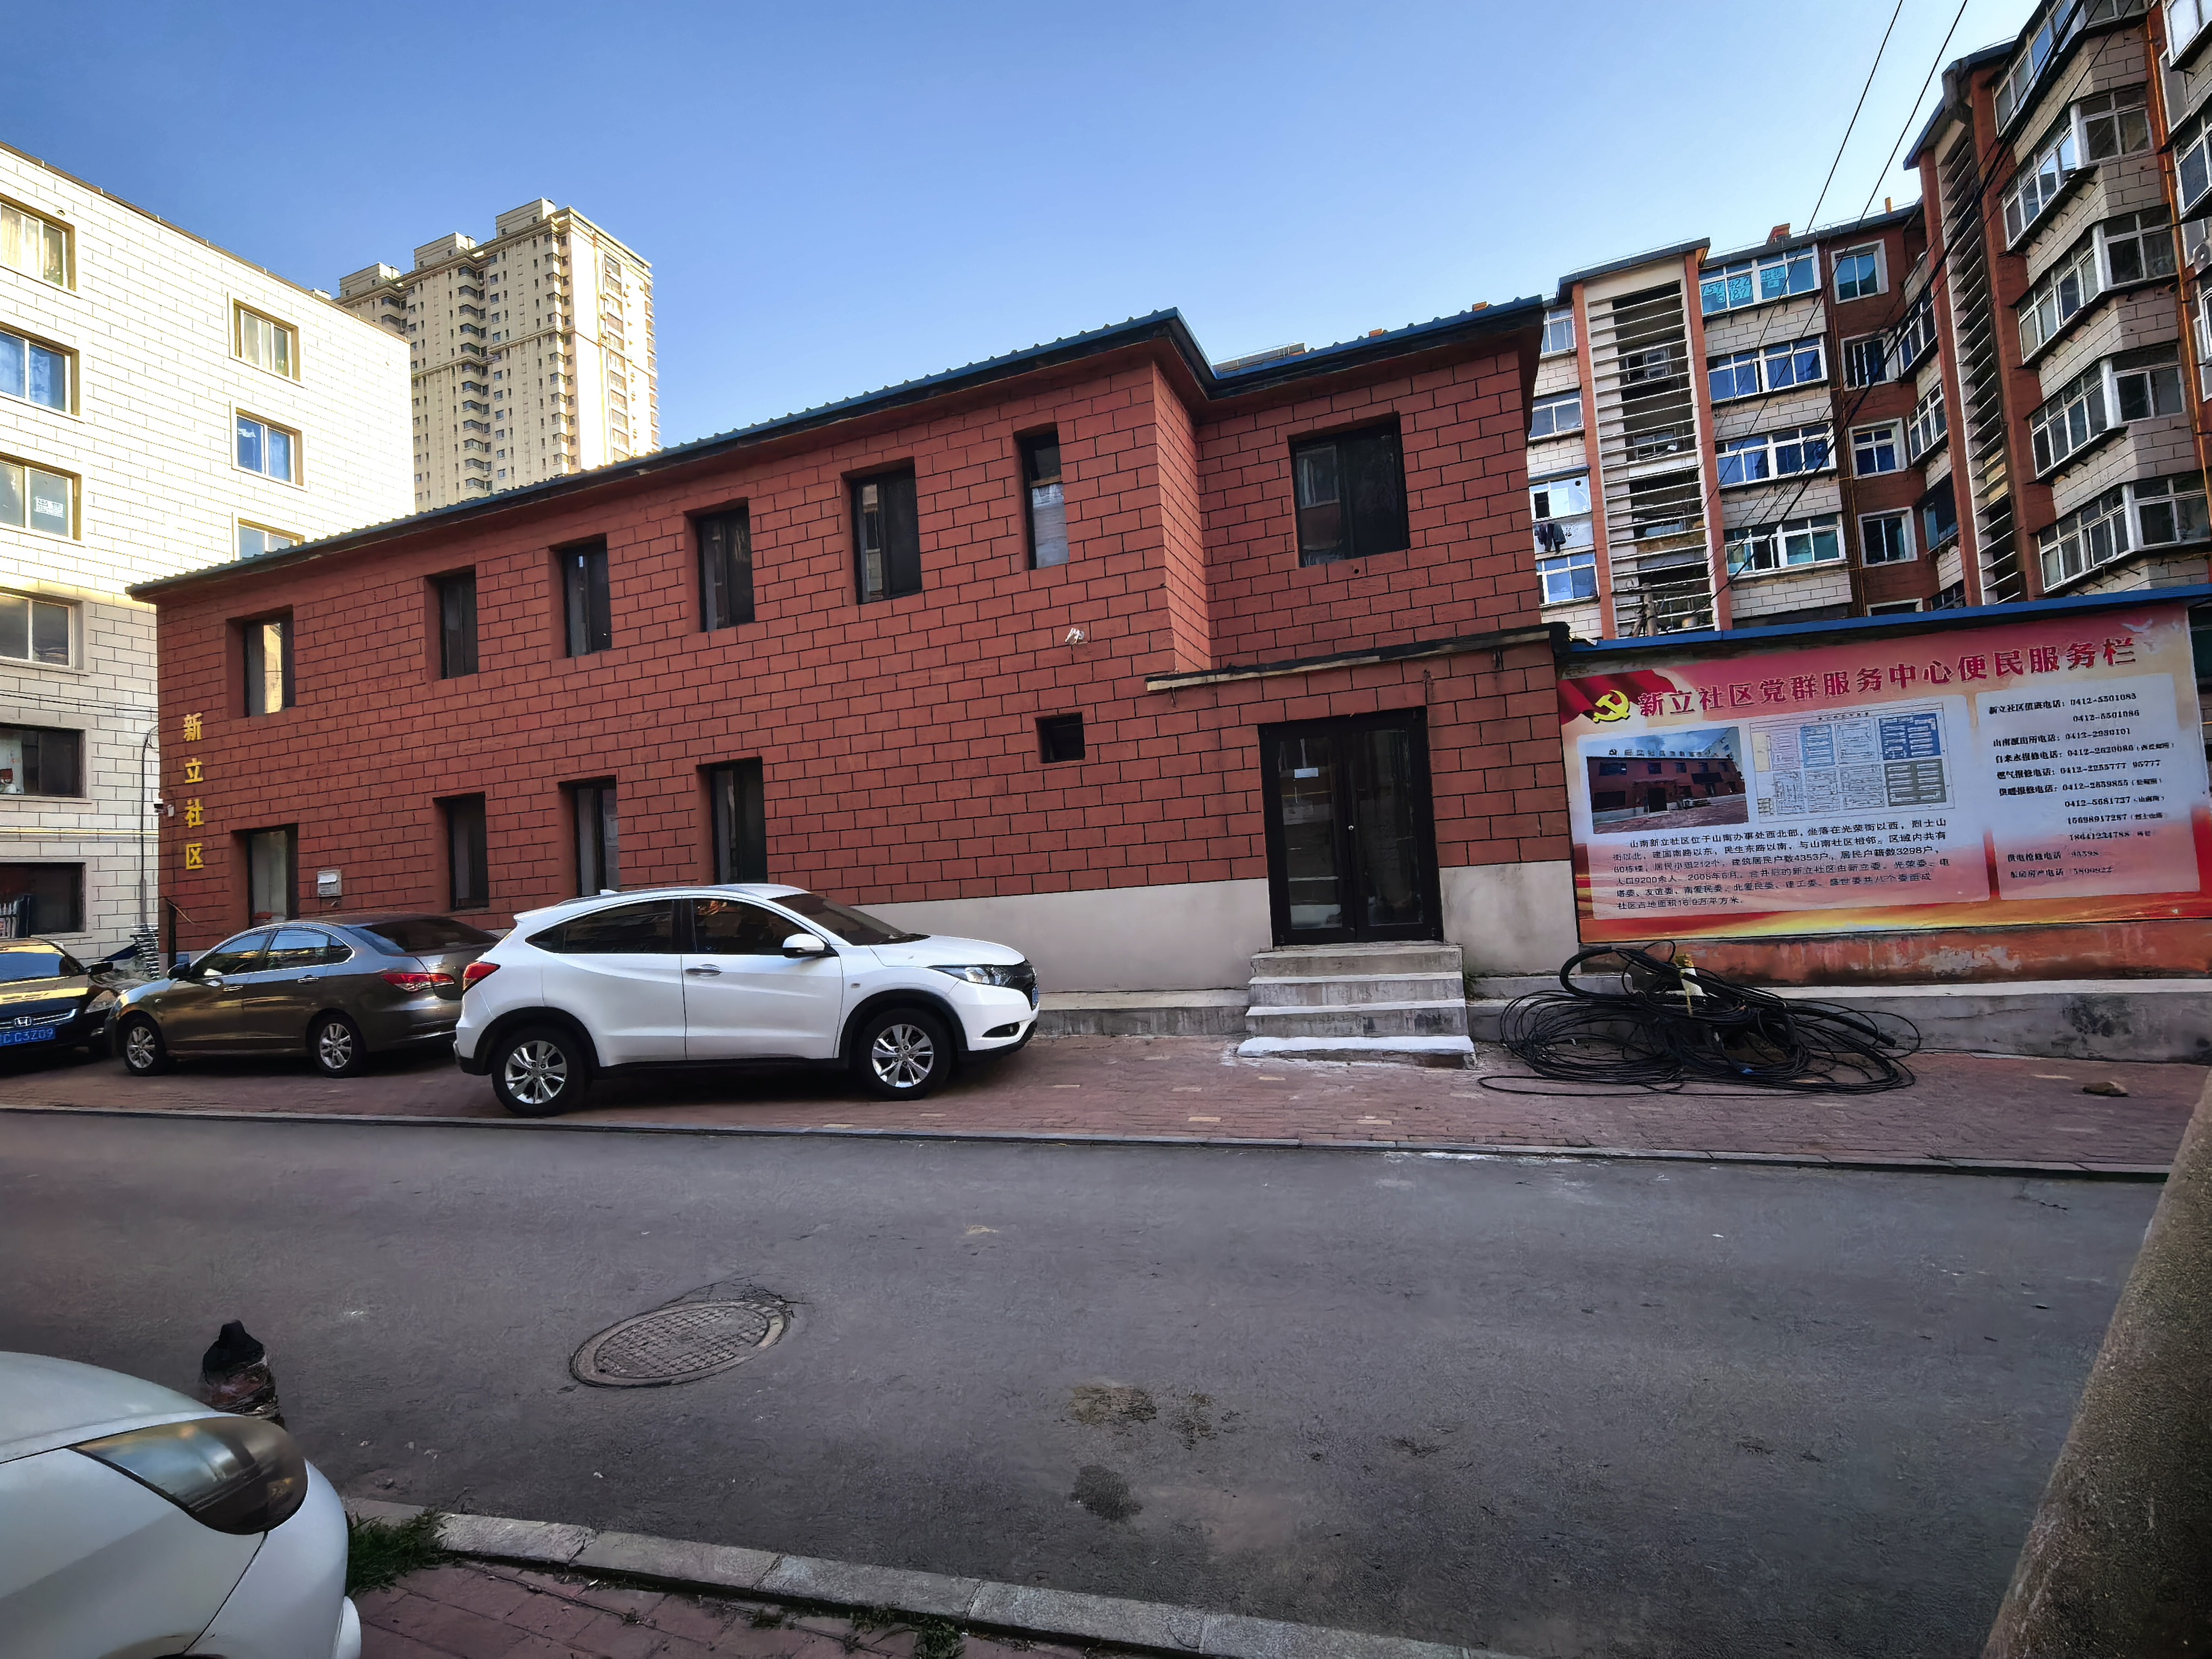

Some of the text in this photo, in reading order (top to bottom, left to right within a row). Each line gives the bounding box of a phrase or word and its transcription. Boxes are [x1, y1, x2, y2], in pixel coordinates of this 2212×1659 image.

[1639, 638, 2136, 717] 新立社区党群服务中心便民服务栏
[183, 712, 205, 870] 新立社区
